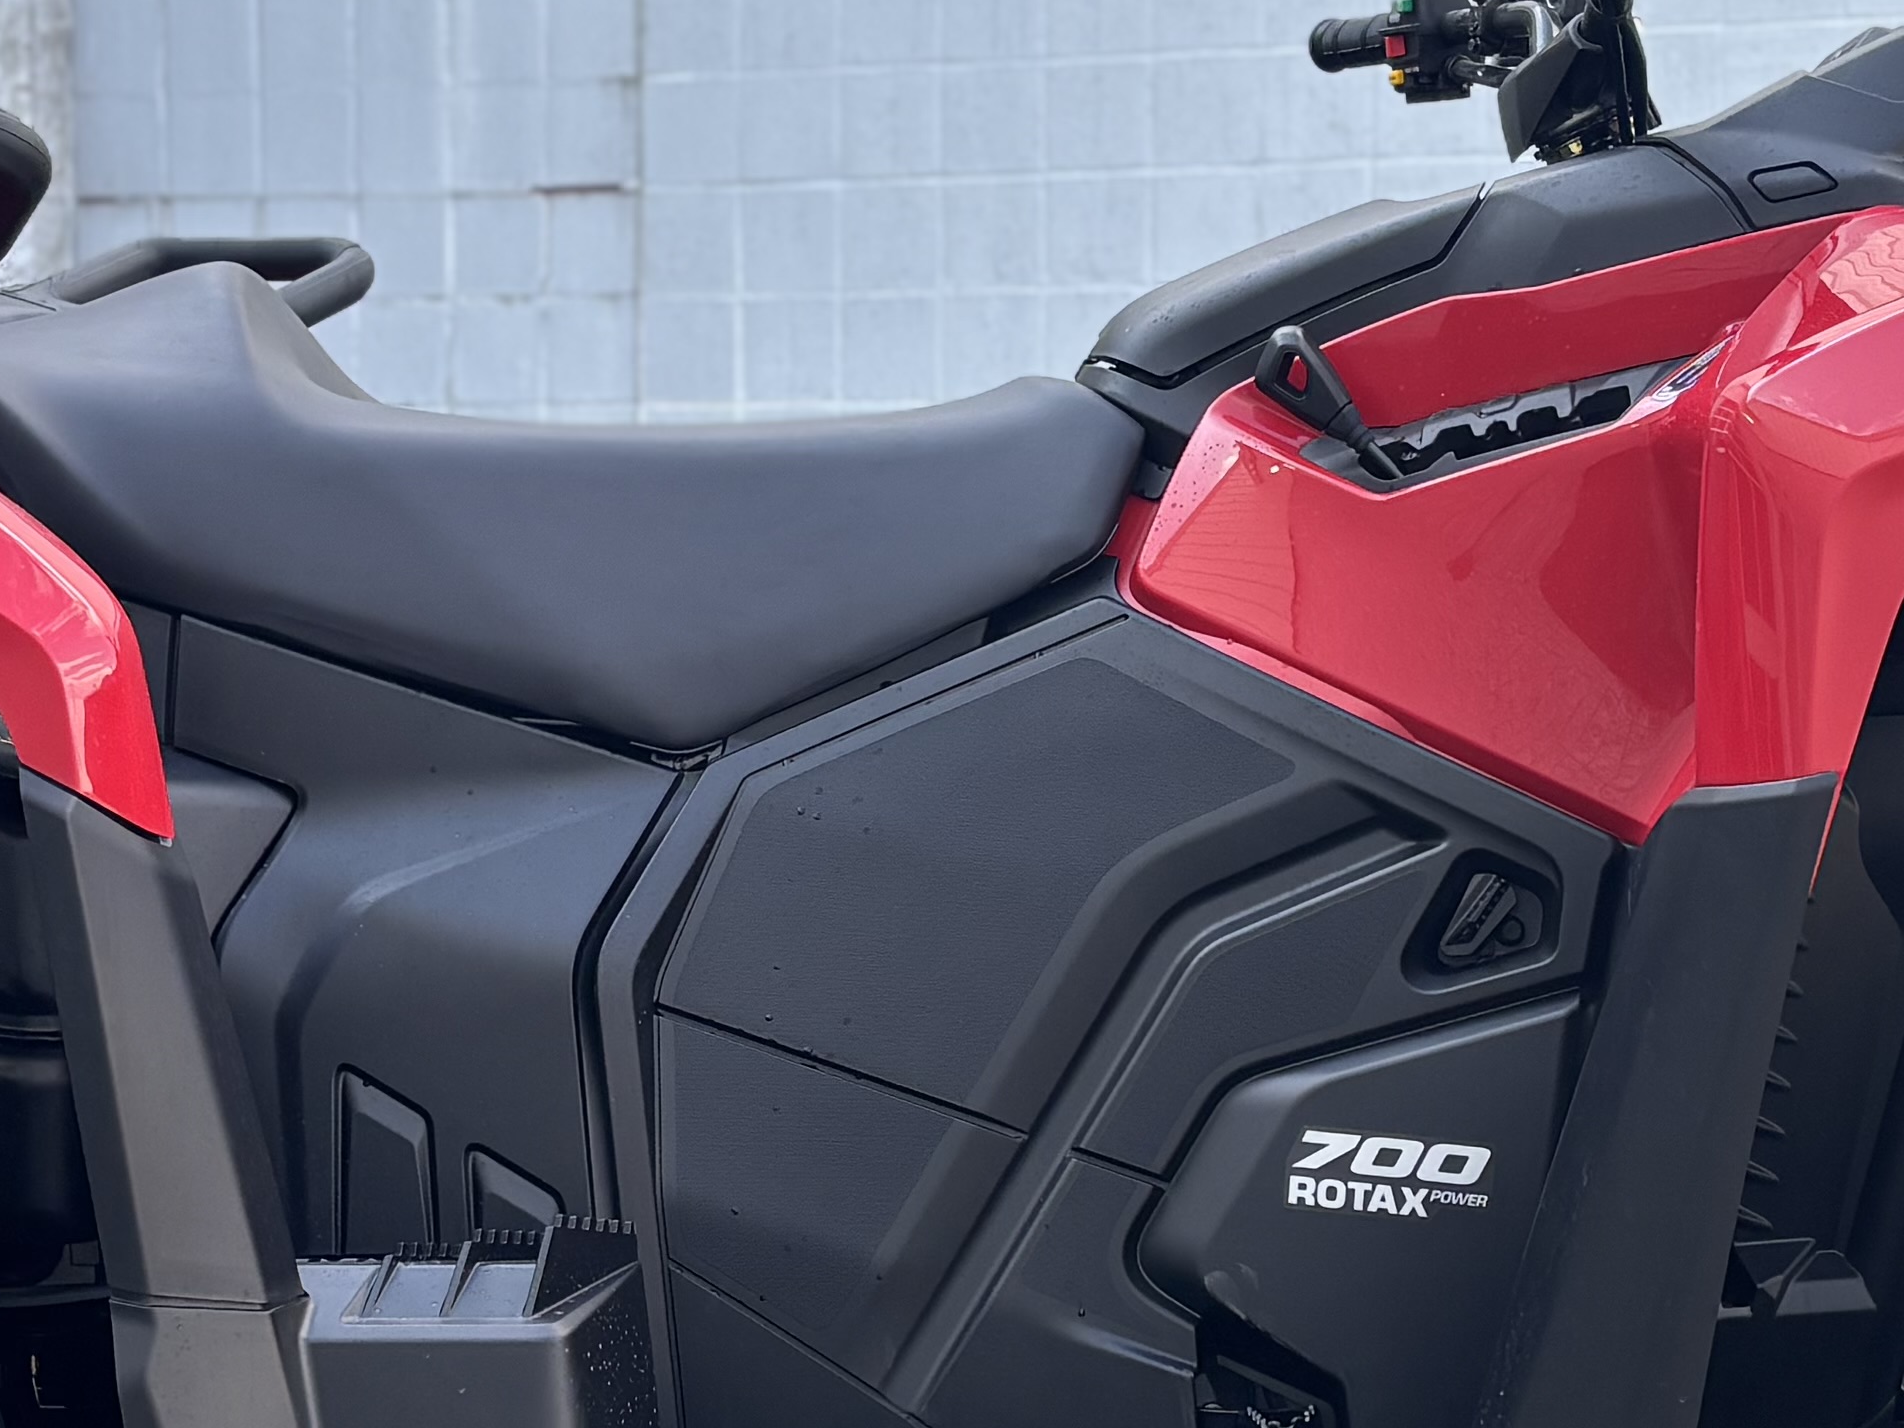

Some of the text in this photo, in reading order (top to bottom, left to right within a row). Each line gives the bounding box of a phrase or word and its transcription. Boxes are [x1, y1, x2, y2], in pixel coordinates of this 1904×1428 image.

[1291, 1129, 1492, 1186] 700
[1287, 1174, 1489, 1218] ROTAX POWER
